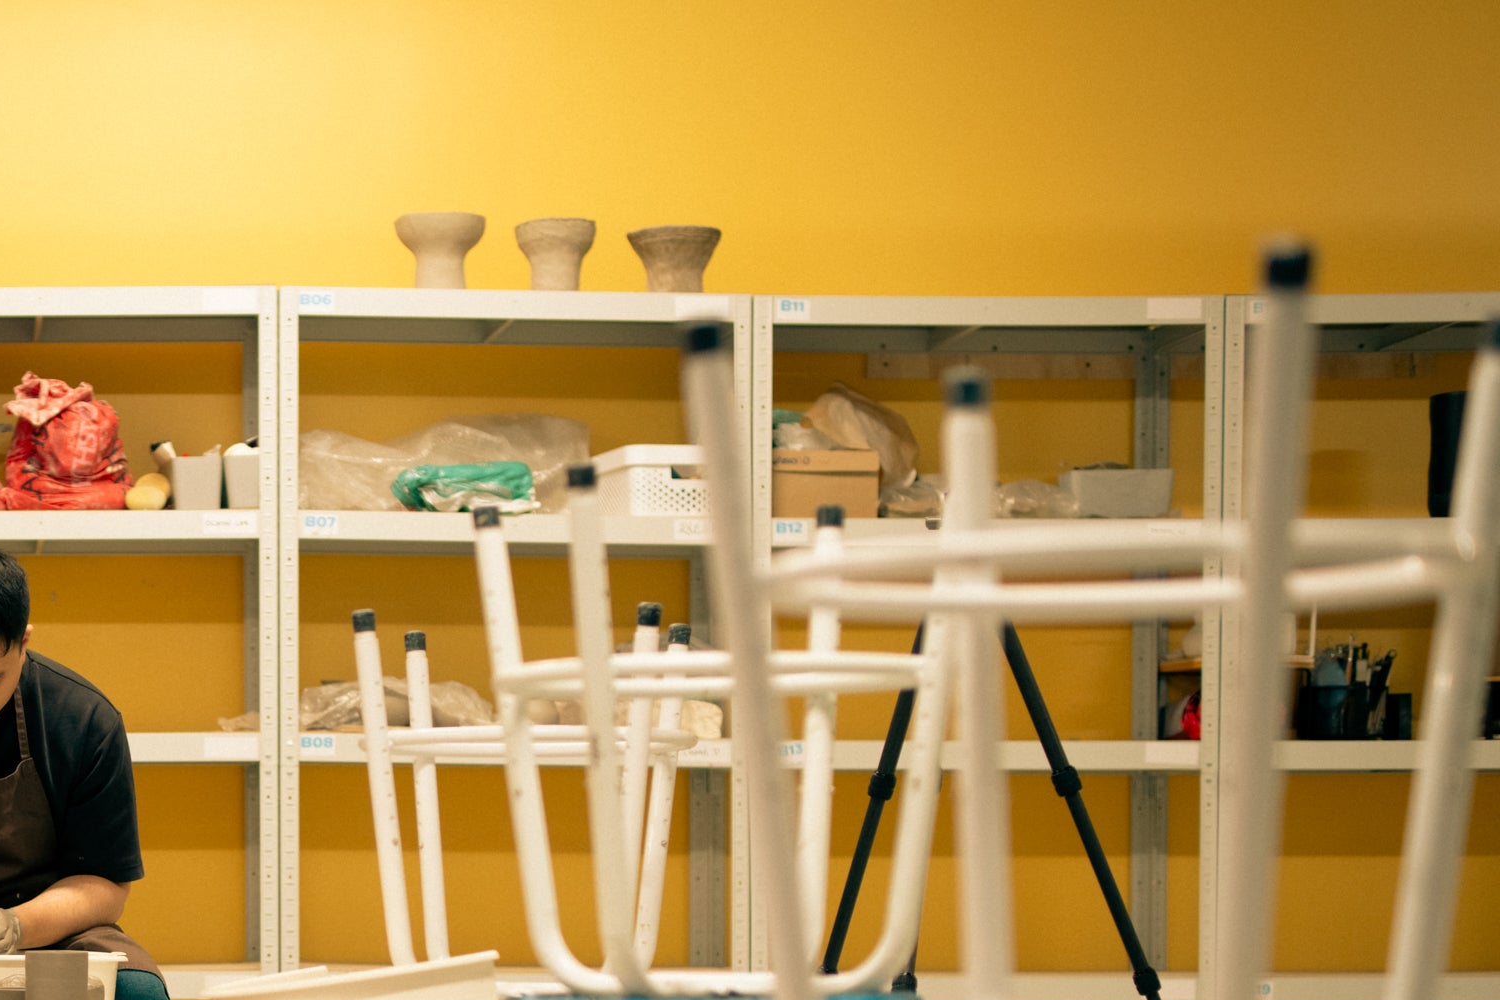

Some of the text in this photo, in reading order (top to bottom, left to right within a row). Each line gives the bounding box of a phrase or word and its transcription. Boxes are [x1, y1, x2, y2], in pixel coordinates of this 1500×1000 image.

[299, 294, 332, 304] B06
[781, 300, 804, 312] B11
[305, 516, 336, 527] B07
[776, 522, 802, 534] B12
[301, 737, 333, 748] B08
